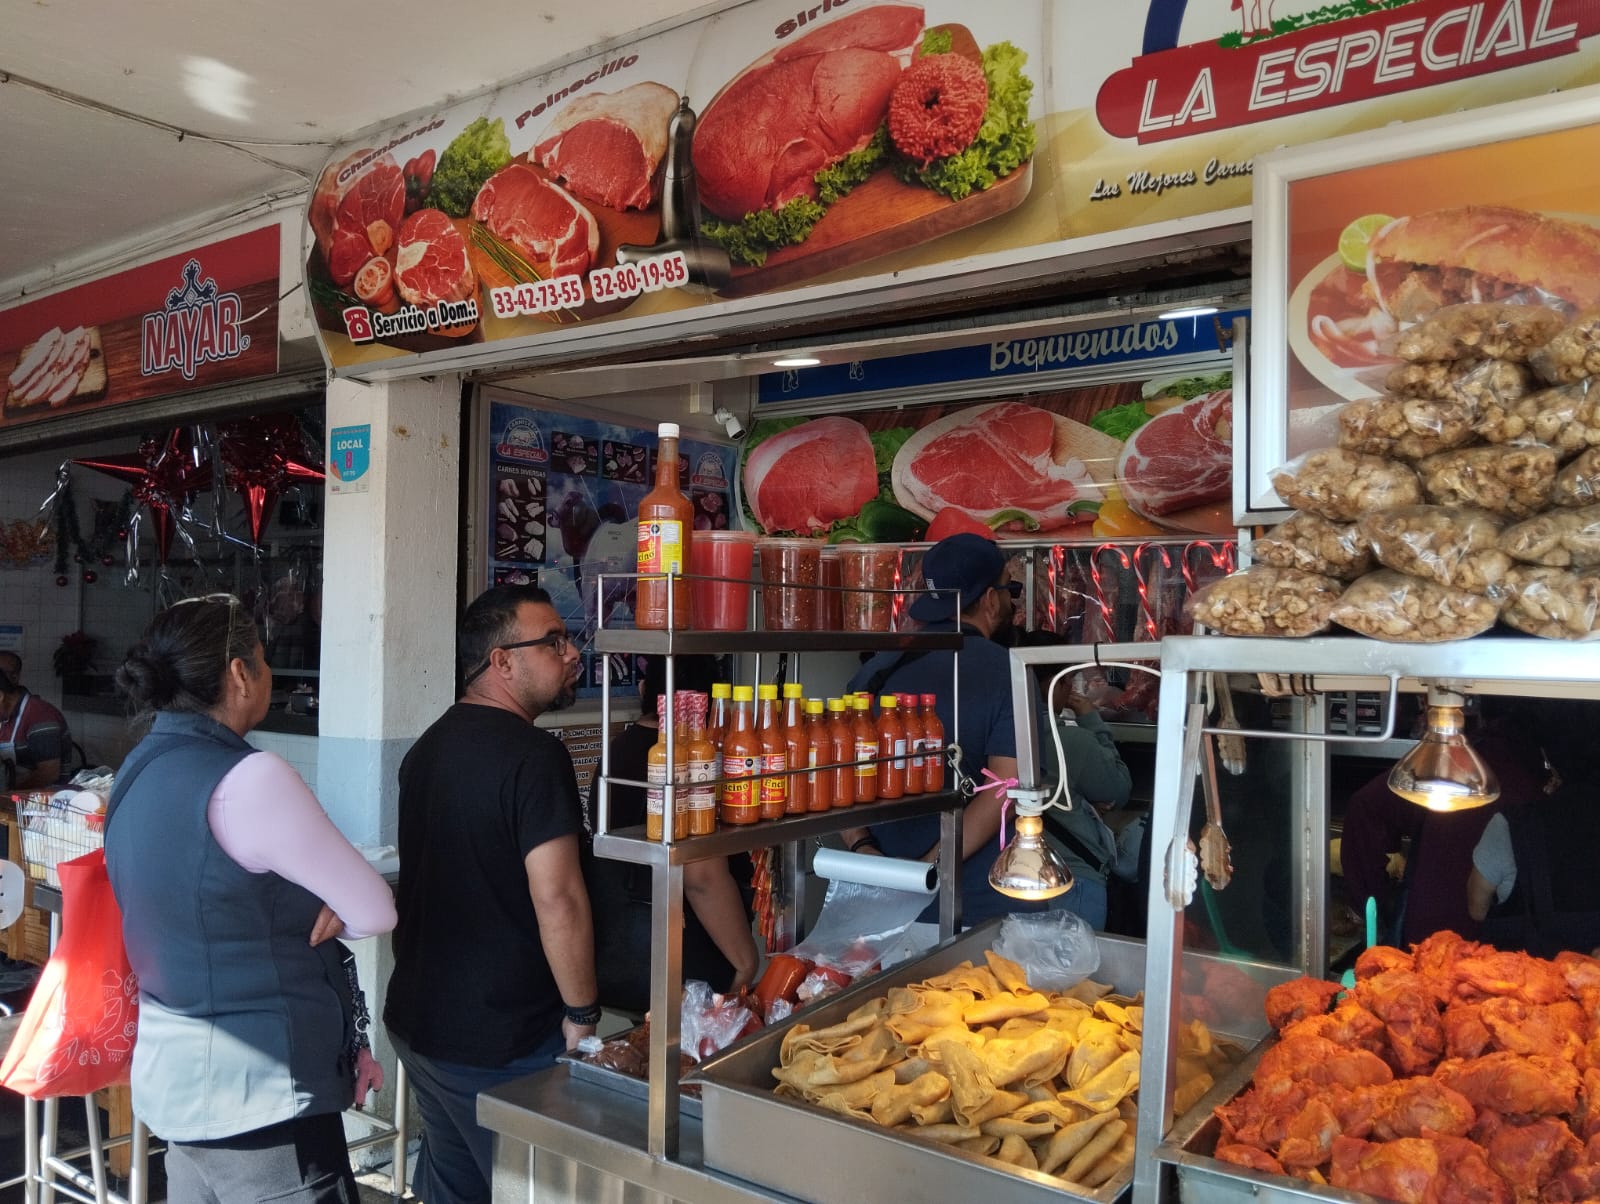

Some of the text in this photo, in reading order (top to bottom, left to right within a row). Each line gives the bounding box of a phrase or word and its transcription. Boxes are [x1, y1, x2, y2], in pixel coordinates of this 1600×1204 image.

[1138, 0, 1579, 133] LA ESPECIAL
[1089, 179, 1121, 202] Las
[1126, 167, 1198, 197] Mejores
[494, 256, 686, 314] 33-42-73-55 32-80-19-85
[143, 296, 242, 378] NAYAR
[374, 300, 477, 335] Servicio a Dom.:
[990, 320, 1179, 371] Bienvenidos
[336, 439, 363, 450] LOCAL
[497, 465, 546, 477] CARNES DIVERSAS
